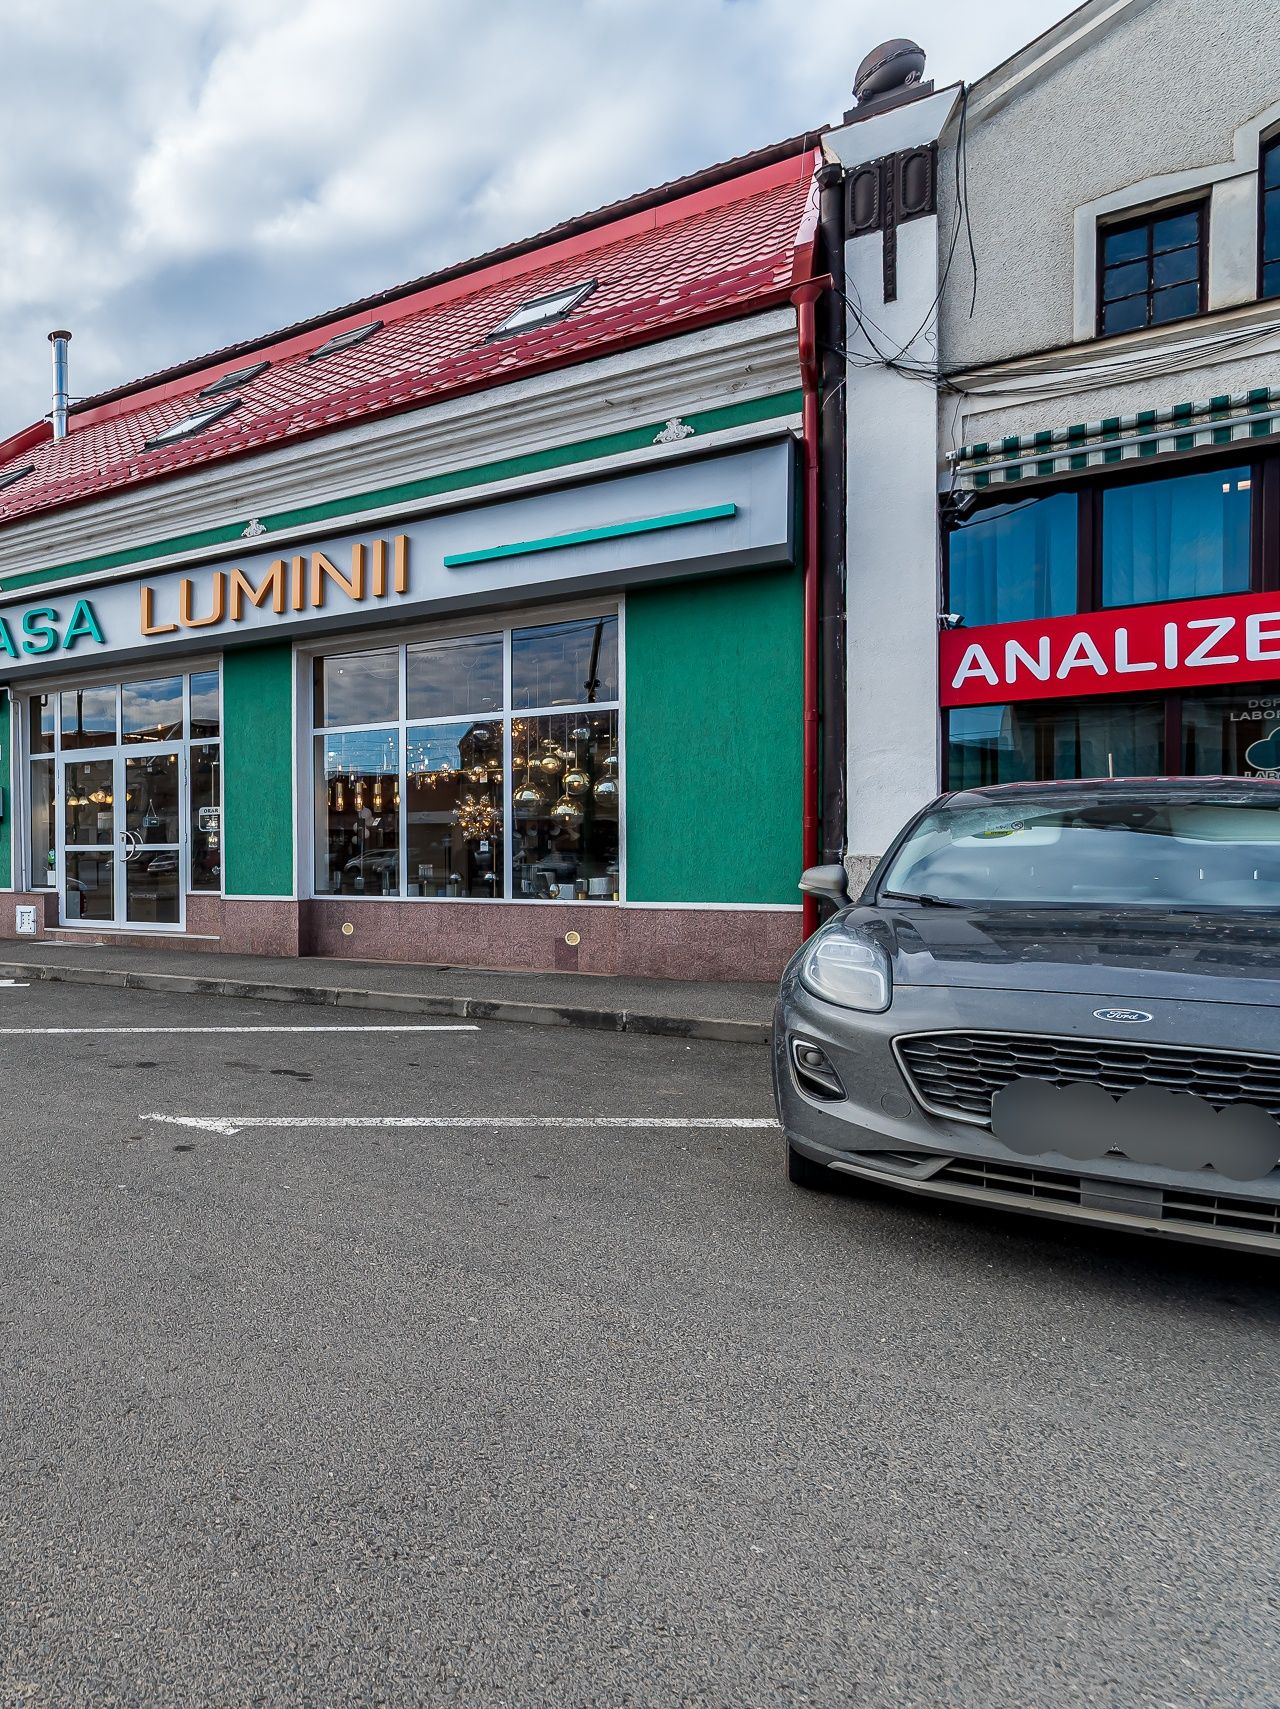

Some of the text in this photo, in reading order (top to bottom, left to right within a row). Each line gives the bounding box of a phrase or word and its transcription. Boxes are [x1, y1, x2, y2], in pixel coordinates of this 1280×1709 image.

[140, 534, 409, 636] LUMINII
[951, 611, 1280, 689] ANALIZE
[1244, 771, 1280, 780] LAB
[1106, 1010, 1139, 1020] Ford
